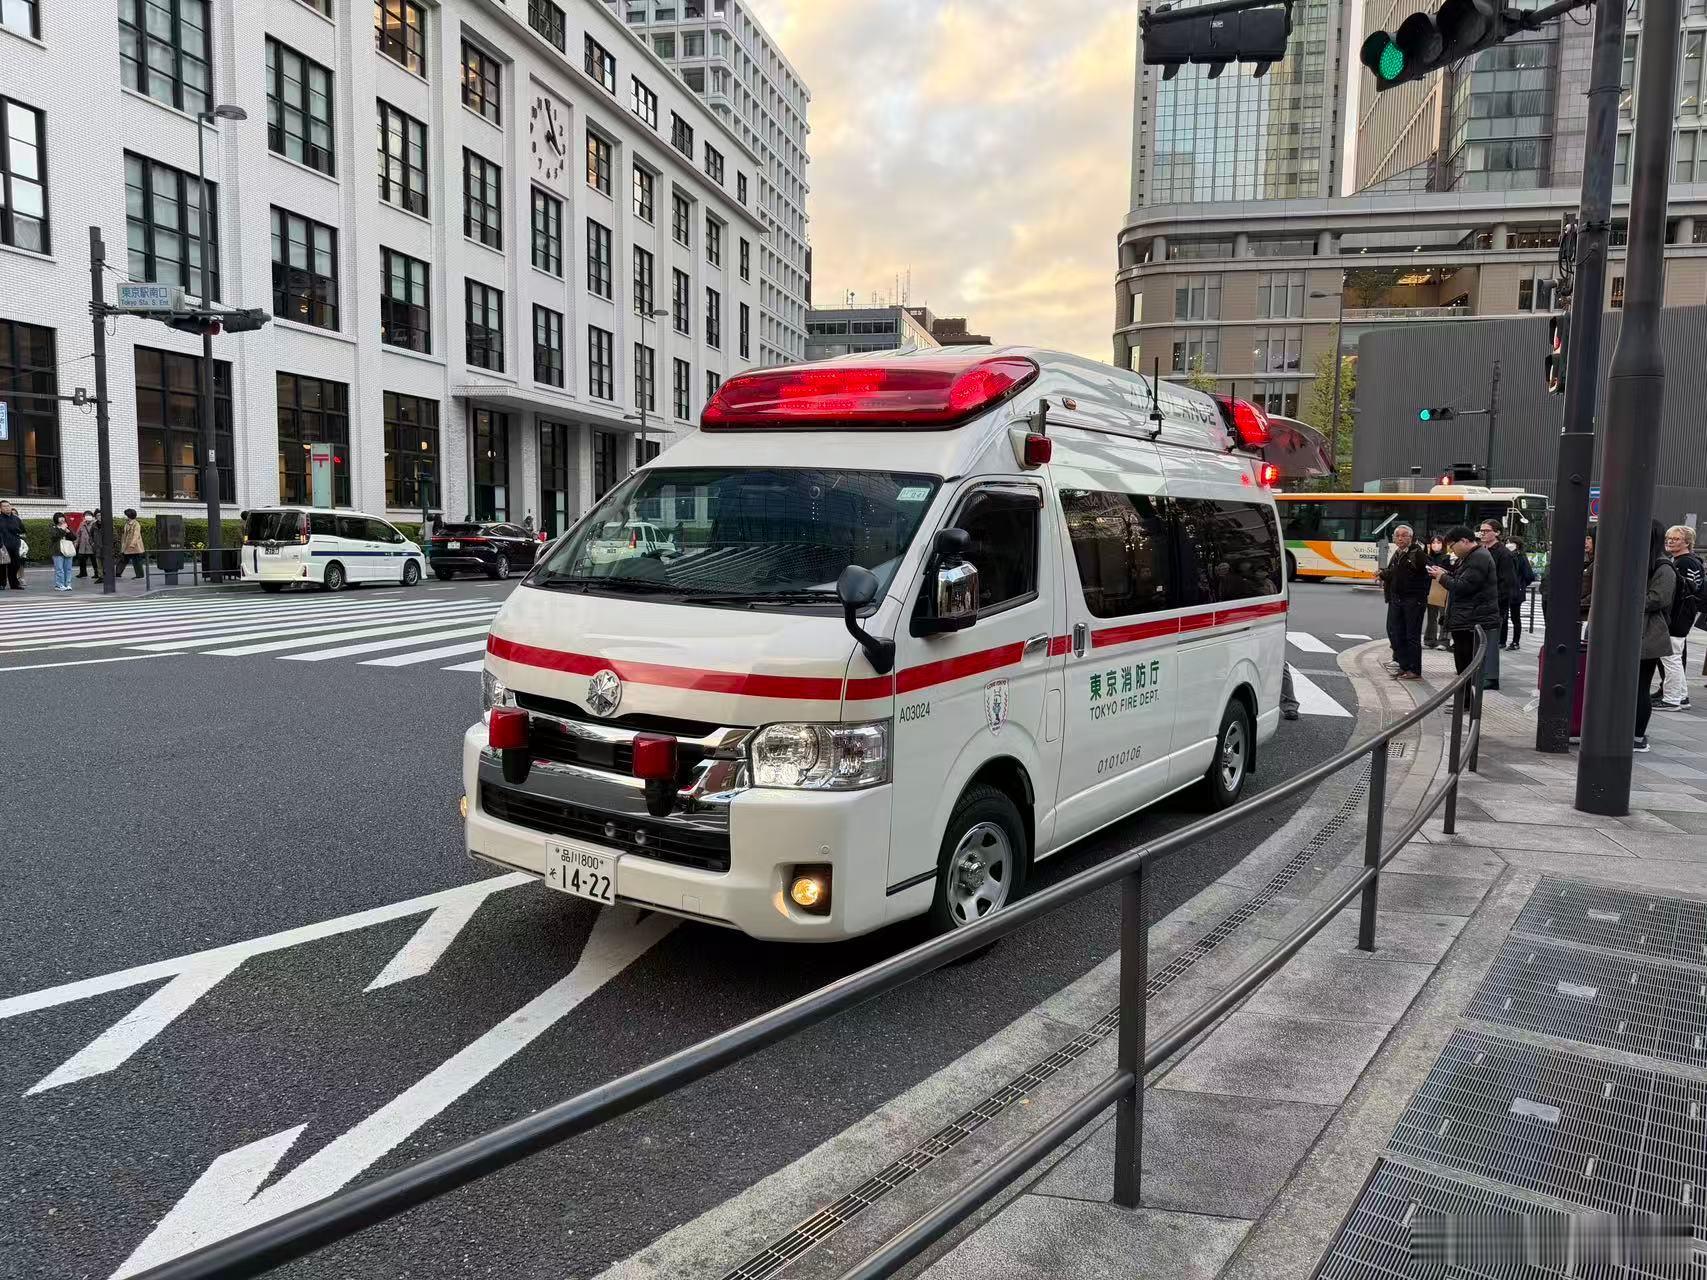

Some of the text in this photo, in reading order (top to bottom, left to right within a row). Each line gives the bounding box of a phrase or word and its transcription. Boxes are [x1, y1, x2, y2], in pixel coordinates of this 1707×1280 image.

[121, 286, 168, 298] 東京駅南口
[1130, 384, 1217, 426] AMULANCE
[1089, 659, 1160, 701] 東京消防庁
[899, 701, 931, 724] A03024
[1089, 688, 1160, 721] TOKYO FIRE DEPT.
[1097, 745, 1142, 774] 01010106
[549, 864, 611, 901] そ 14-22
